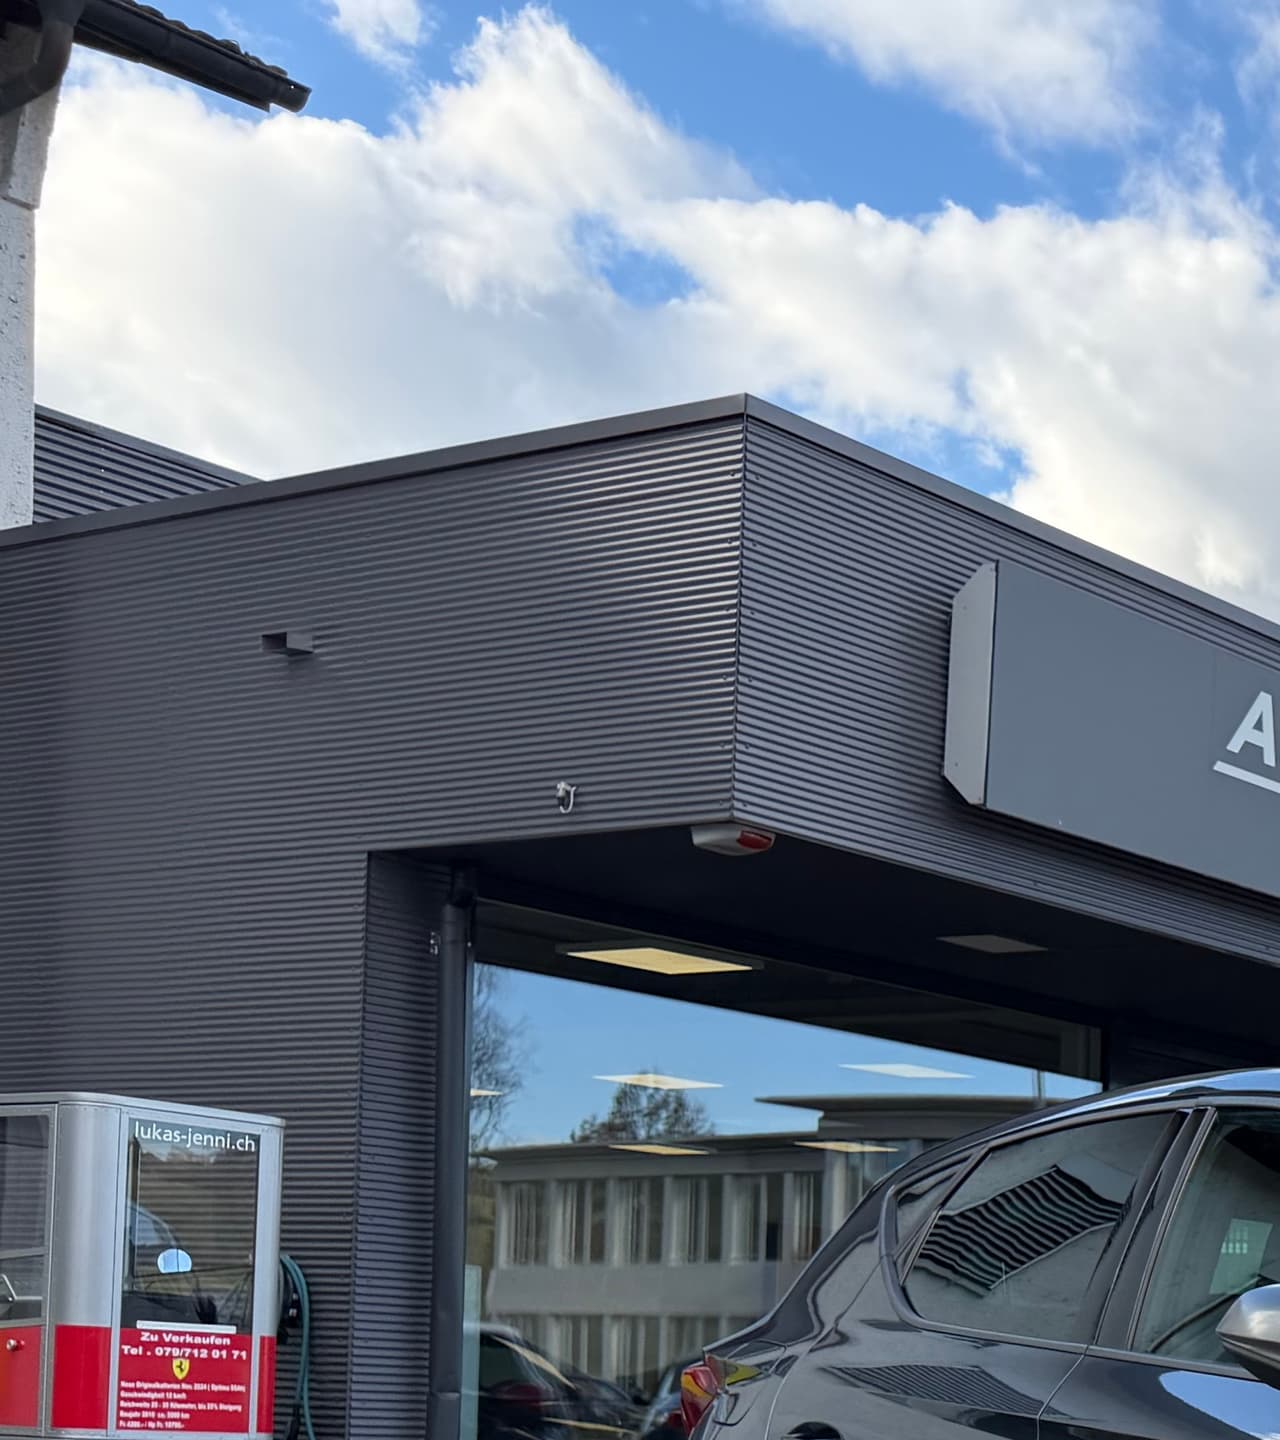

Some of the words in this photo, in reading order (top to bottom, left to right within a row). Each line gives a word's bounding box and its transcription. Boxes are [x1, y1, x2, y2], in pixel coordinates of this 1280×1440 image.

[135, 1120, 256, 1152] lukas-jenni.ch
[140, 1331, 159, 1342] Zu
[162, 1332, 231, 1345] Verkaufen
[211, 1349, 227, 1359] 01
[232, 1350, 247, 1361] 71
